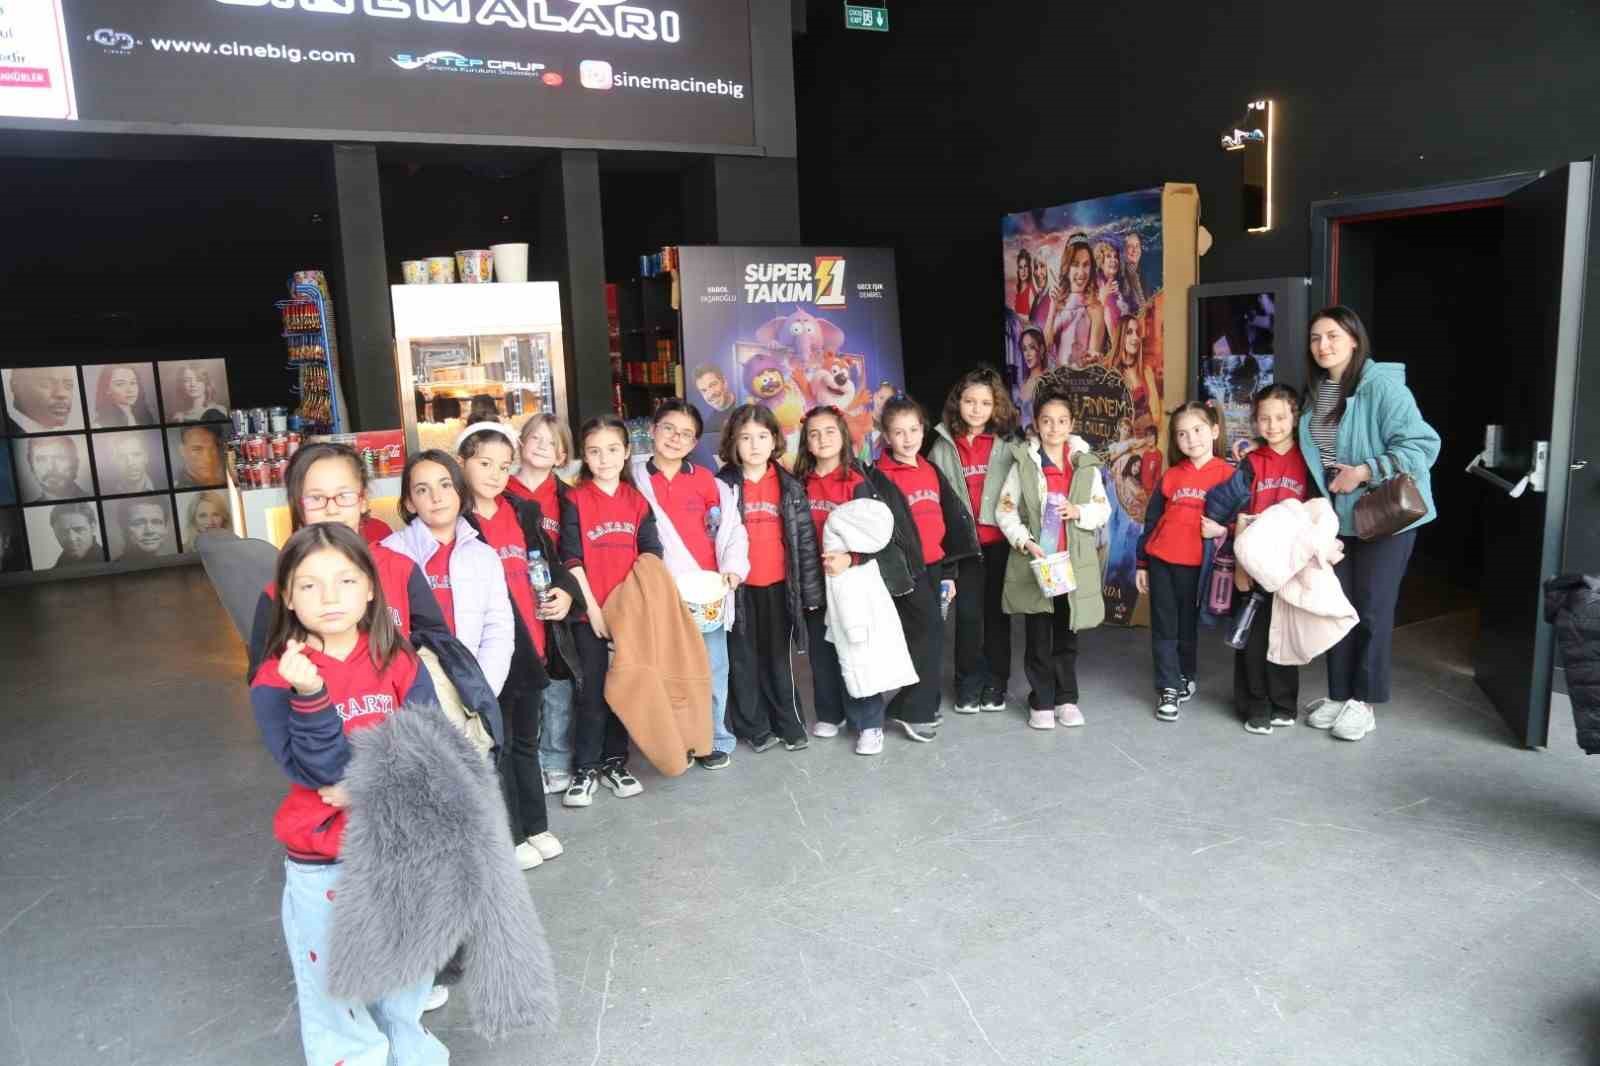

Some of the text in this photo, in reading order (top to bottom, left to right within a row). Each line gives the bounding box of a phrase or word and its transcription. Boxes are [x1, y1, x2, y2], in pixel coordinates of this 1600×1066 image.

[216, 0, 681, 43] EMALARI
[151, 37, 356, 64] www.cinebig.com
[488, 60, 546, 72] GRUP
[613, 72, 744, 99] sinemacinebig
[744, 263, 813, 282] SUPER
[744, 282, 814, 303] TAKIM
